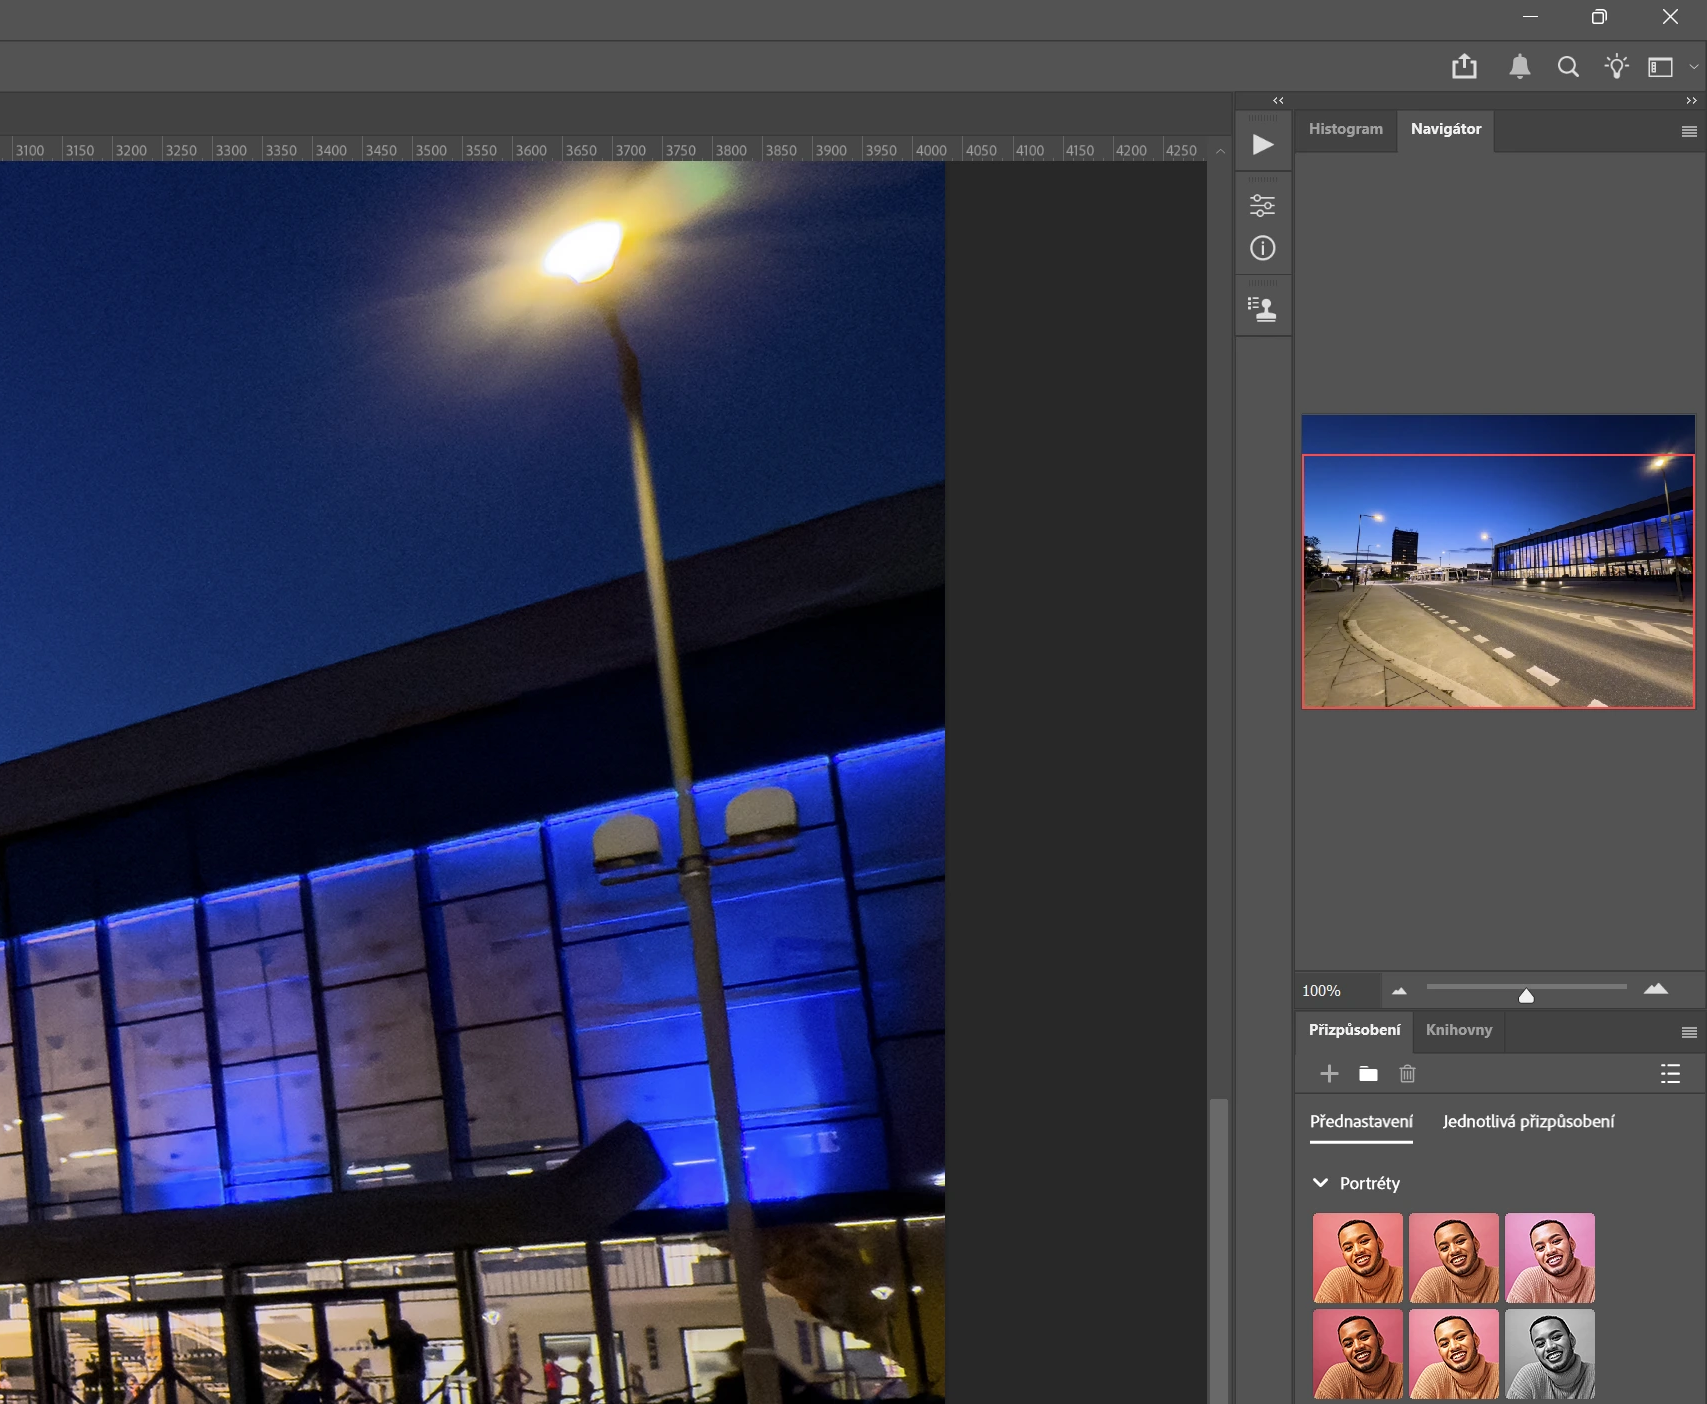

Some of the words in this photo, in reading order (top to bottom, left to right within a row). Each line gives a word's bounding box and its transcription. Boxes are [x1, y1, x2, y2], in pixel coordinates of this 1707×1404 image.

[1310, 123, 1383, 137] Histogram
[1412, 123, 1482, 137] Navigátor
[17, 145, 44, 156] 3100
[67, 145, 94, 156] 3150
[167, 145, 197, 156] 3250
[217, 145, 247, 156] 3300
[317, 145, 347, 156] 3400
[367, 145, 396, 156] 3450
[467, 145, 496, 156] 3550
[517, 145, 547, 156] 3600
[617, 145, 646, 156] 3700
[667, 145, 696, 156] 3750
[767, 145, 796, 156] 3850
[817, 145, 847, 156] 3900
[916, 145, 947, 156] 4000
[966, 145, 996, 156] 4050
[1066, 145, 1094, 156] 4150
[1116, 145, 1147, 156] 4200
[1303, 985, 1340, 996] 100%
[1310, 1023, 1401, 1038] Přizpůsobení
[1427, 1024, 1493, 1038] Knihovny
[1311, 1114, 1413, 1128] Přednastavení
[1443, 1114, 1515, 1129] Jednotlivá
[1521, 1114, 1615, 1131] přizpůsobení
[1341, 1176, 1400, 1193] Portréty
